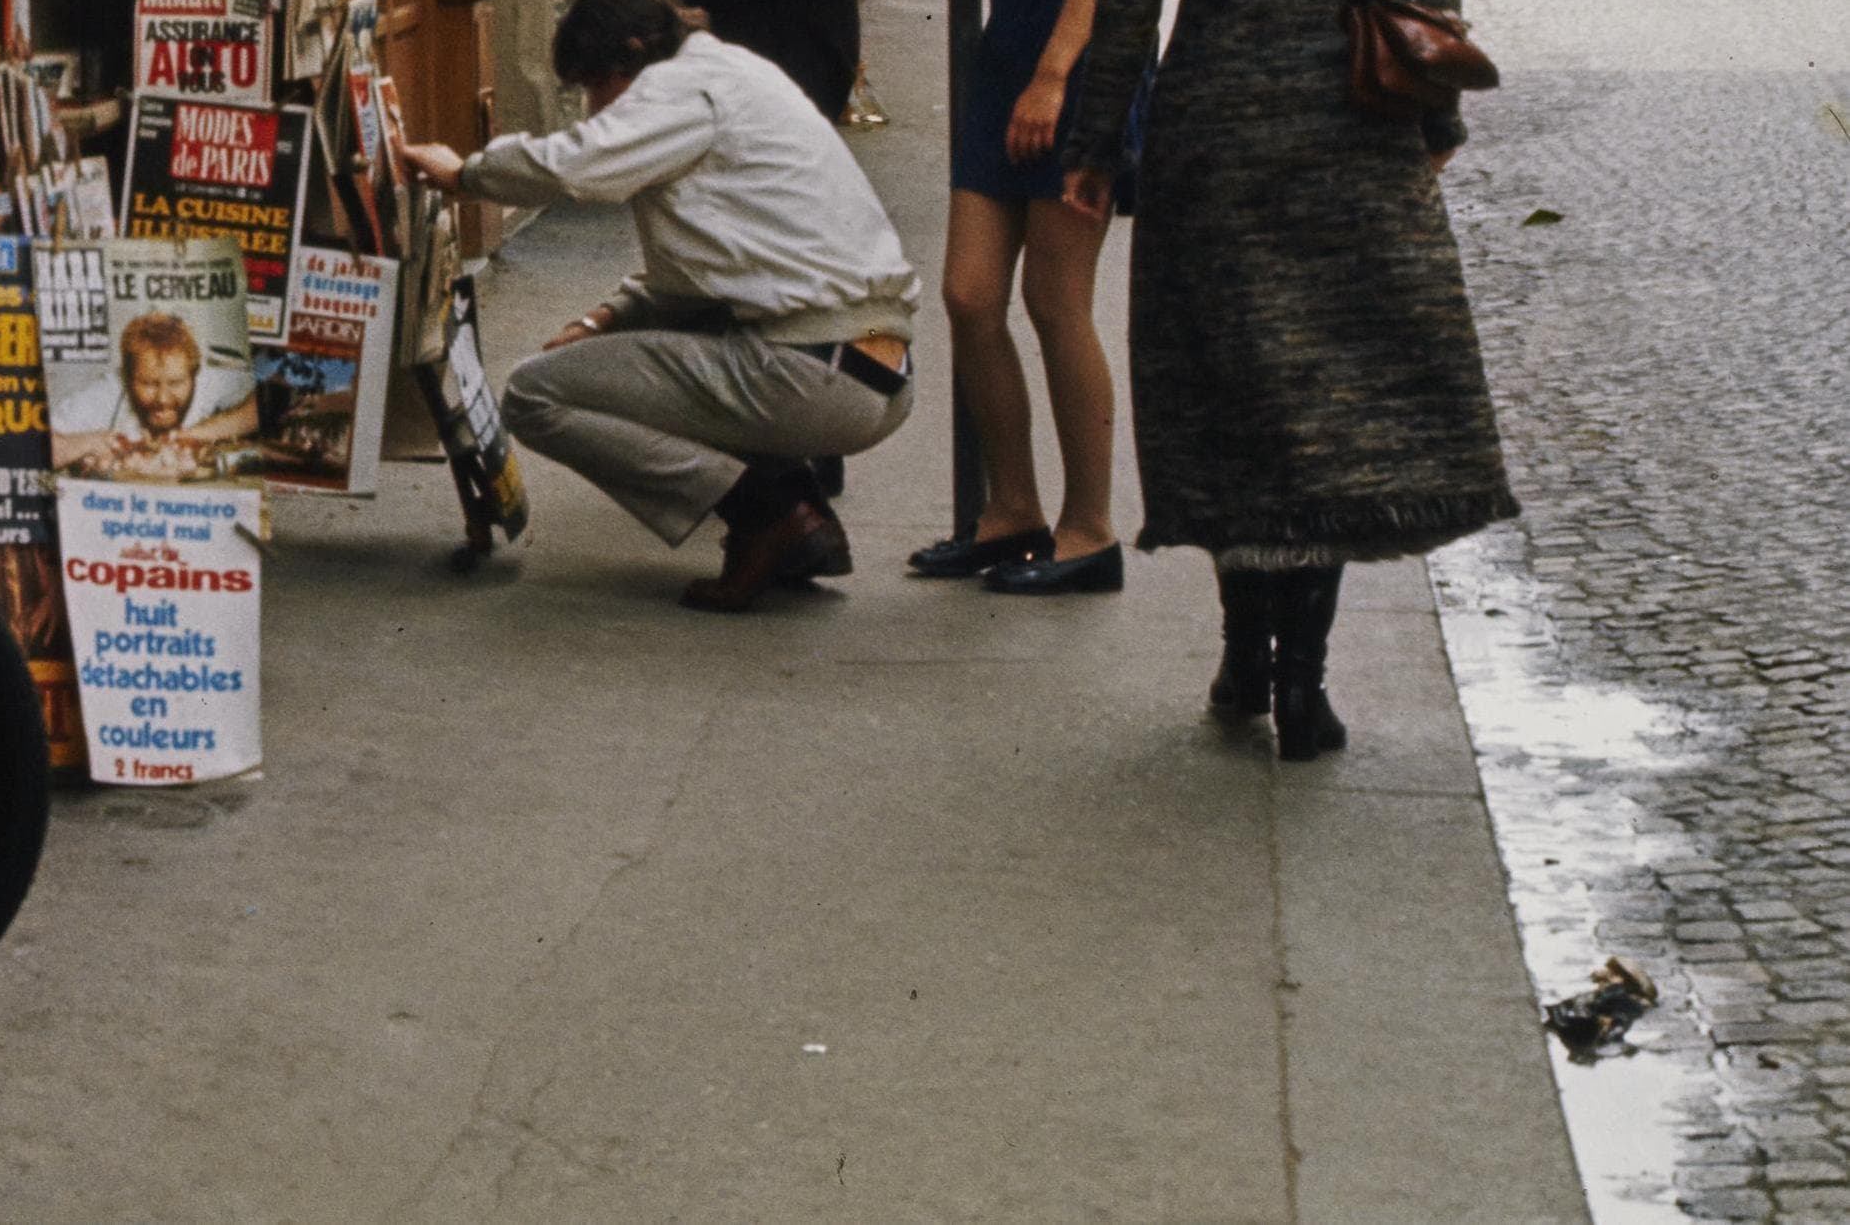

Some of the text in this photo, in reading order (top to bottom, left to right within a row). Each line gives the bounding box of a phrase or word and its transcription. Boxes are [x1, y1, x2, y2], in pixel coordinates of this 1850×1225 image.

[146, 19, 260, 44] ASSURANCE
[147, 39, 258, 88] AUTO
[176, 70, 227, 93] VOUS
[176, 103, 256, 148] MODES
[171, 142, 272, 187] de PARIS
[133, 192, 291, 228] LA CUISINE
[113, 274, 238, 300] LE CERVEAU
[303, 292, 378, 319] bouquets
[82, 492, 237, 519] dans le numéro
[101, 519, 212, 541] spécial mai
[66, 557, 254, 594] copains
[124, 596, 179, 628] huit
[94, 628, 217, 657] portraits
[80, 657, 244, 693] détachables
[130, 695, 168, 718] en
[98, 722, 217, 751] couleurs
[114, 757, 194, 780] 2 francs
